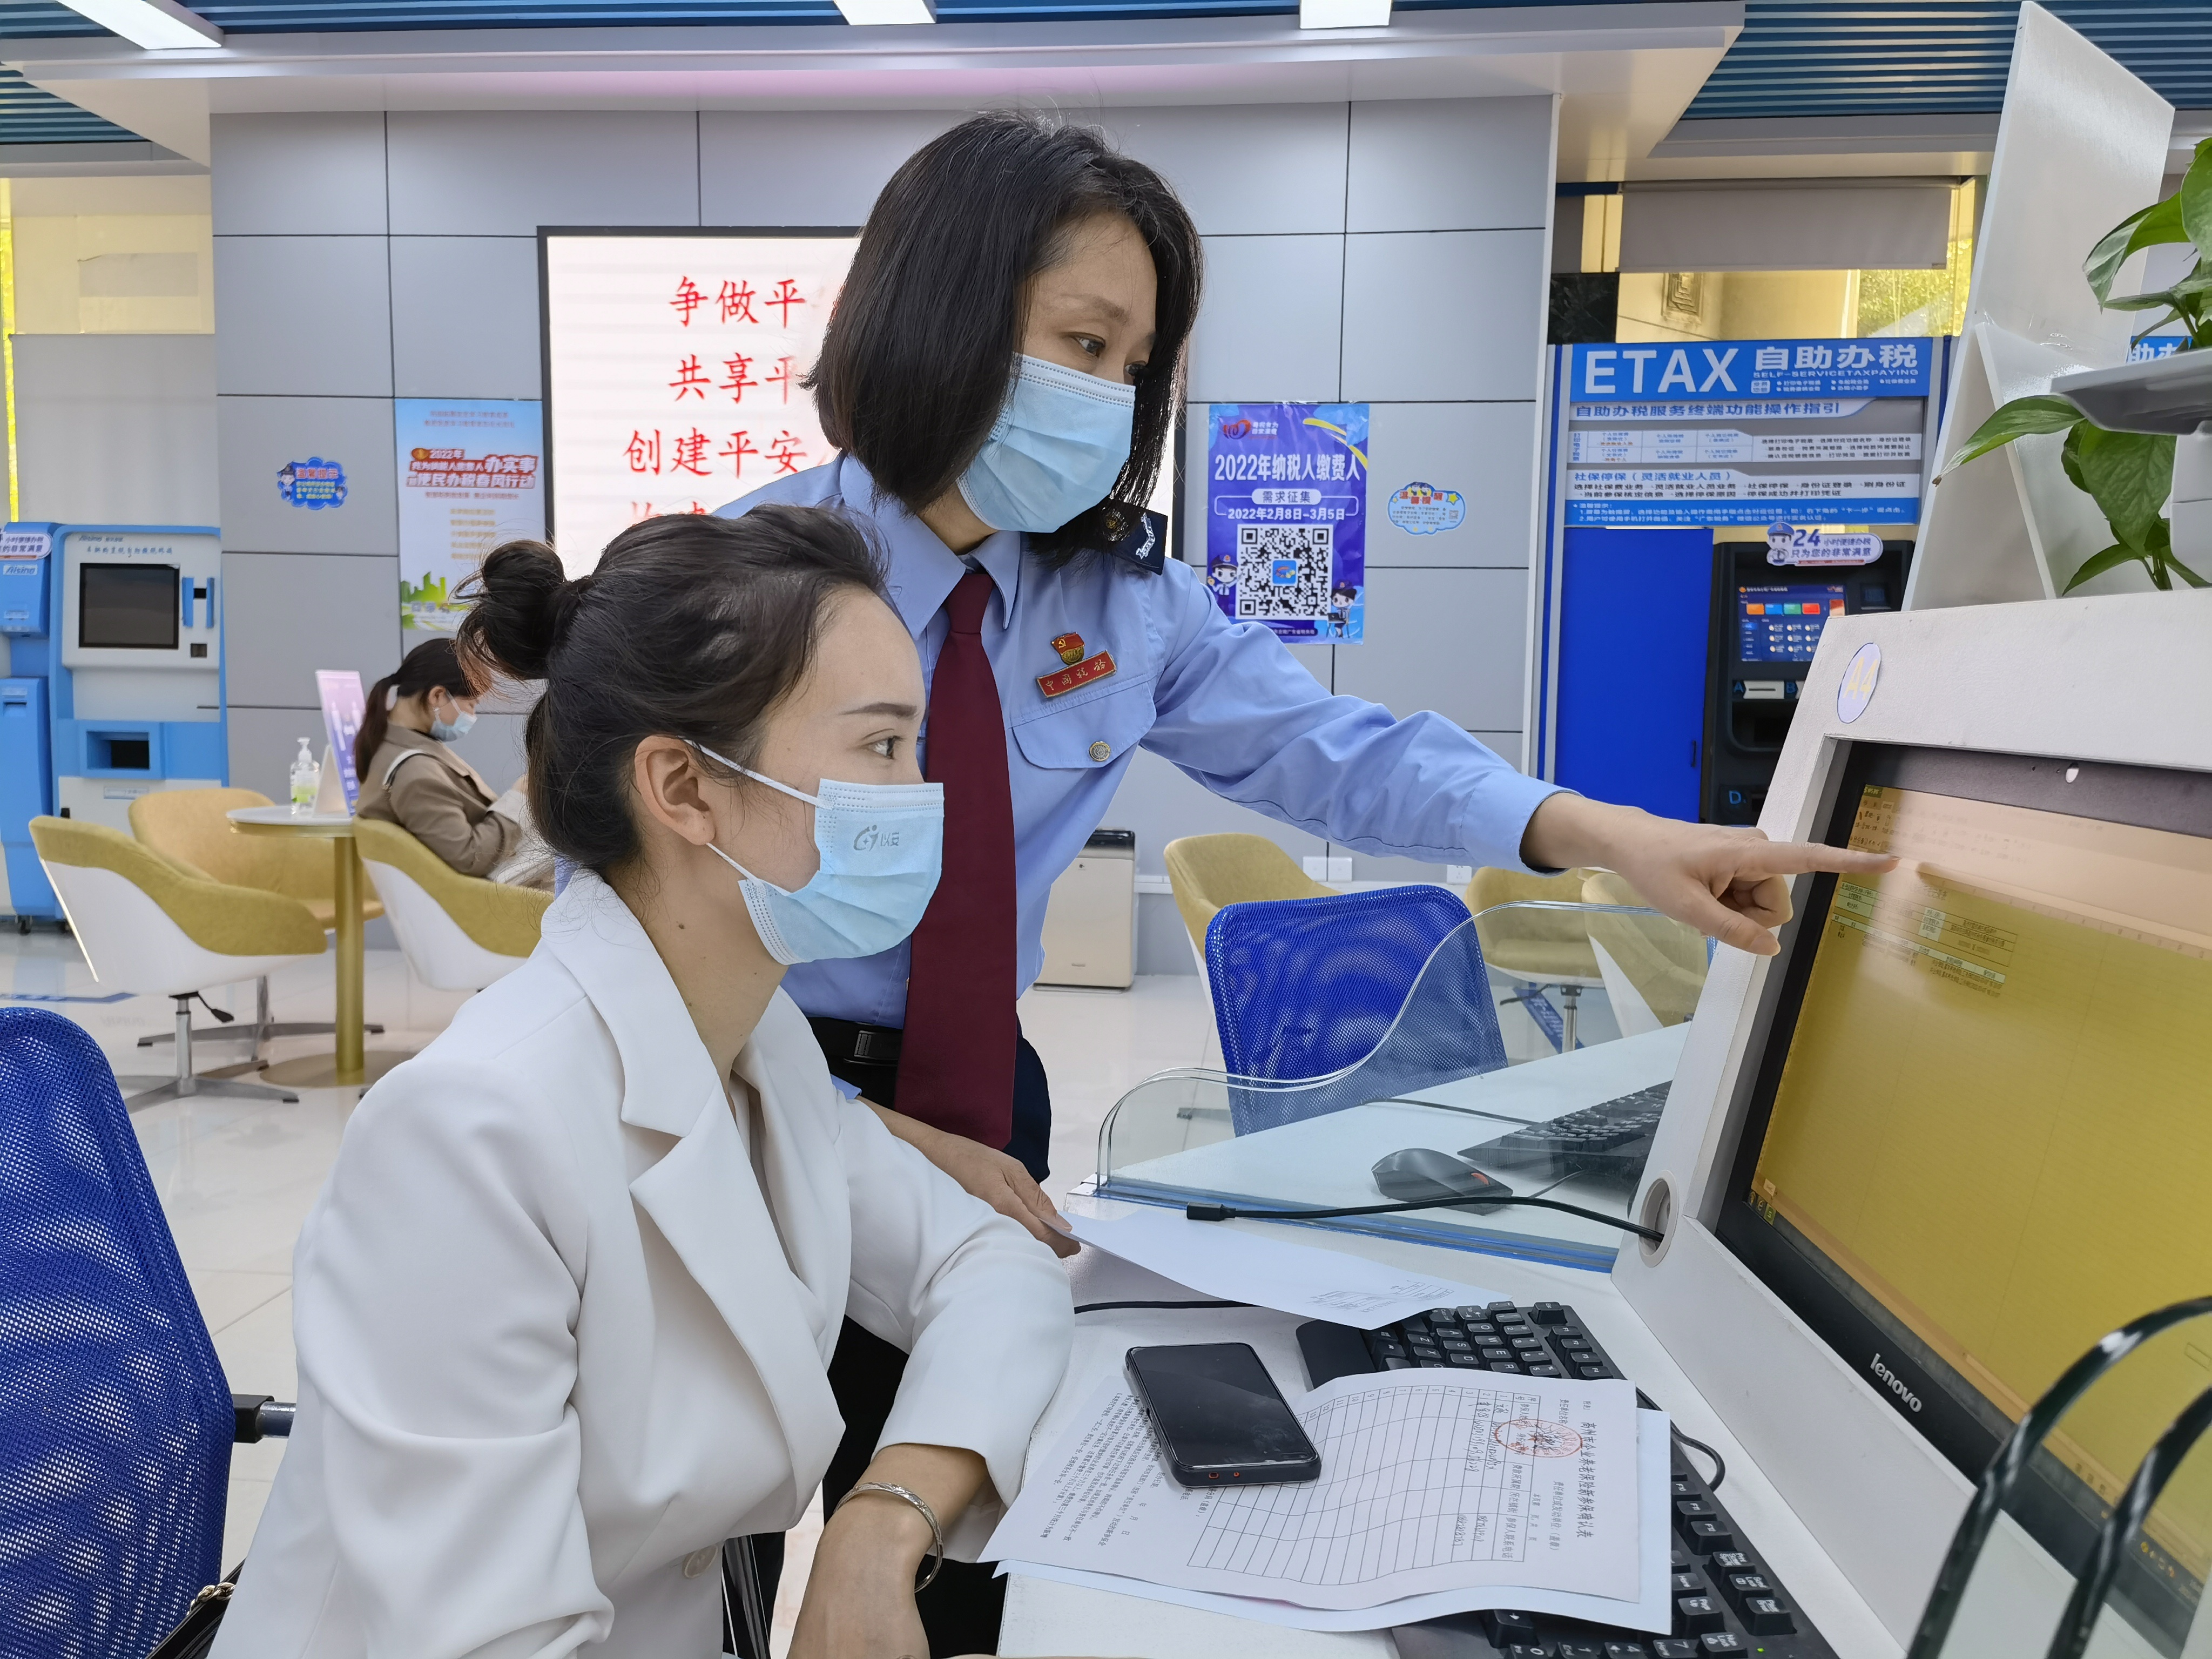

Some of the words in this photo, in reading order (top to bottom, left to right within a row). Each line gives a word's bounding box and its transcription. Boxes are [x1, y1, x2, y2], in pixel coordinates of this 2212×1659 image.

[669, 276, 807, 328] 争做平
[1755, 344, 1918, 370] 自助办税
[1585, 348, 1739, 394] ETAX
[1576, 402, 1839, 417] 自助办税服务终端功能操作指引
[429, 449, 464, 459] 2022年
[622, 428, 807, 479] 创建平安
[1214, 454, 1360, 481] 2022年纳税人缴费人
[1575, 471, 1731, 482] 社保停保（灵活就业人员）
[1262, 491, 1311, 503] 需求征集
[1228, 508, 1345, 520] 2022年2月8日-3月5日
[1793, 529, 1821, 547] 24
[1790, 548, 1871, 558] 只为您的非常满意
[1046, 659, 1106, 691] 中国税务
[1734, 682, 1744, 693] A
[1786, 682, 1797, 693] B
[1869, 1352, 1923, 1414] lenovo
[1575, 1422, 1596, 1538] 高州市企业养老保险新参保确认表
[1676, 1483, 1687, 1492] F10
[1506, 1492, 1520, 1513] 所在镇街
[1705, 1523, 1716, 1532] F12
[1501, 1517, 1516, 1559] 参保人联系电话
